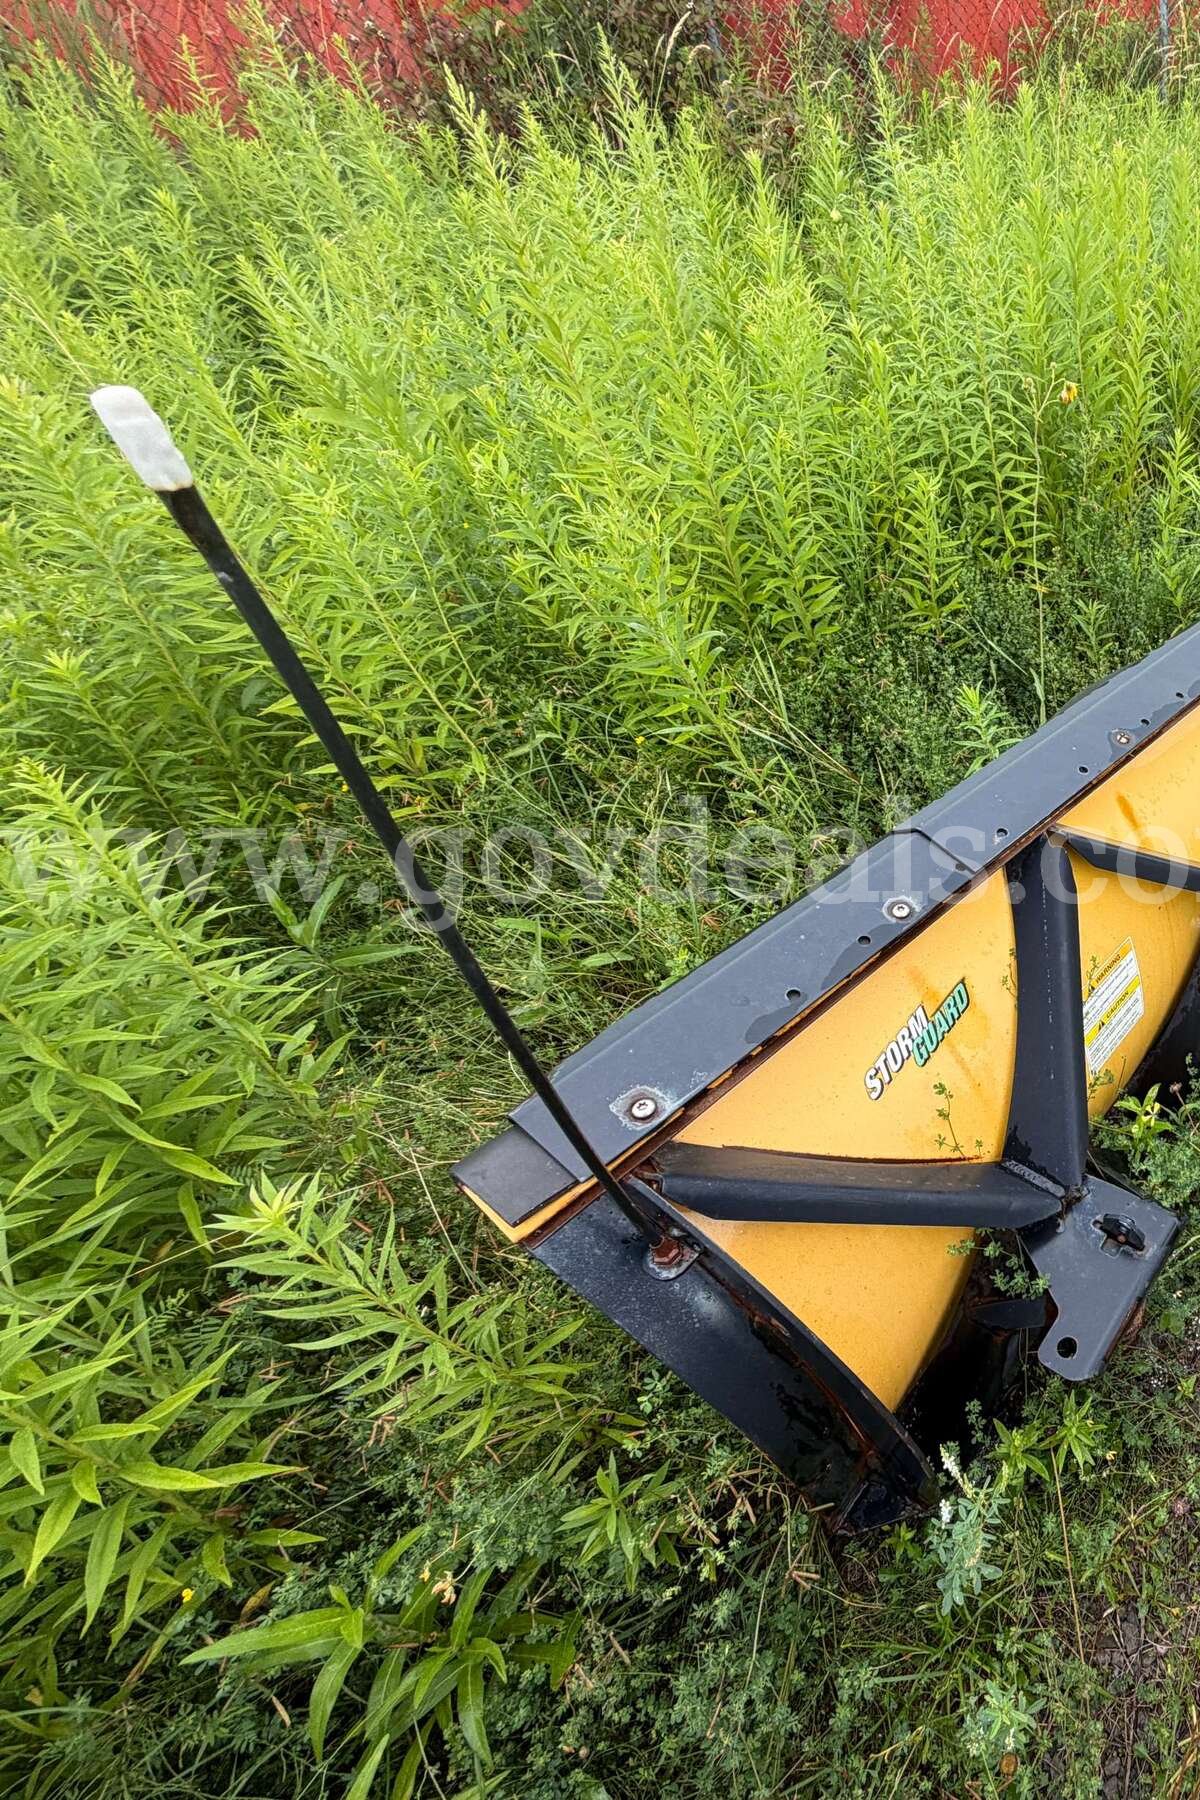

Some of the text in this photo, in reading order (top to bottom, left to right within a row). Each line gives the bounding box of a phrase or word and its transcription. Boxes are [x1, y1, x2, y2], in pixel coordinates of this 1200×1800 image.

[1095, 954, 1122, 984] WARNING
[911, 978, 970, 1068] GUARD
[1105, 991, 1130, 1019] CAUTION
[864, 1004, 929, 1101] STORM
